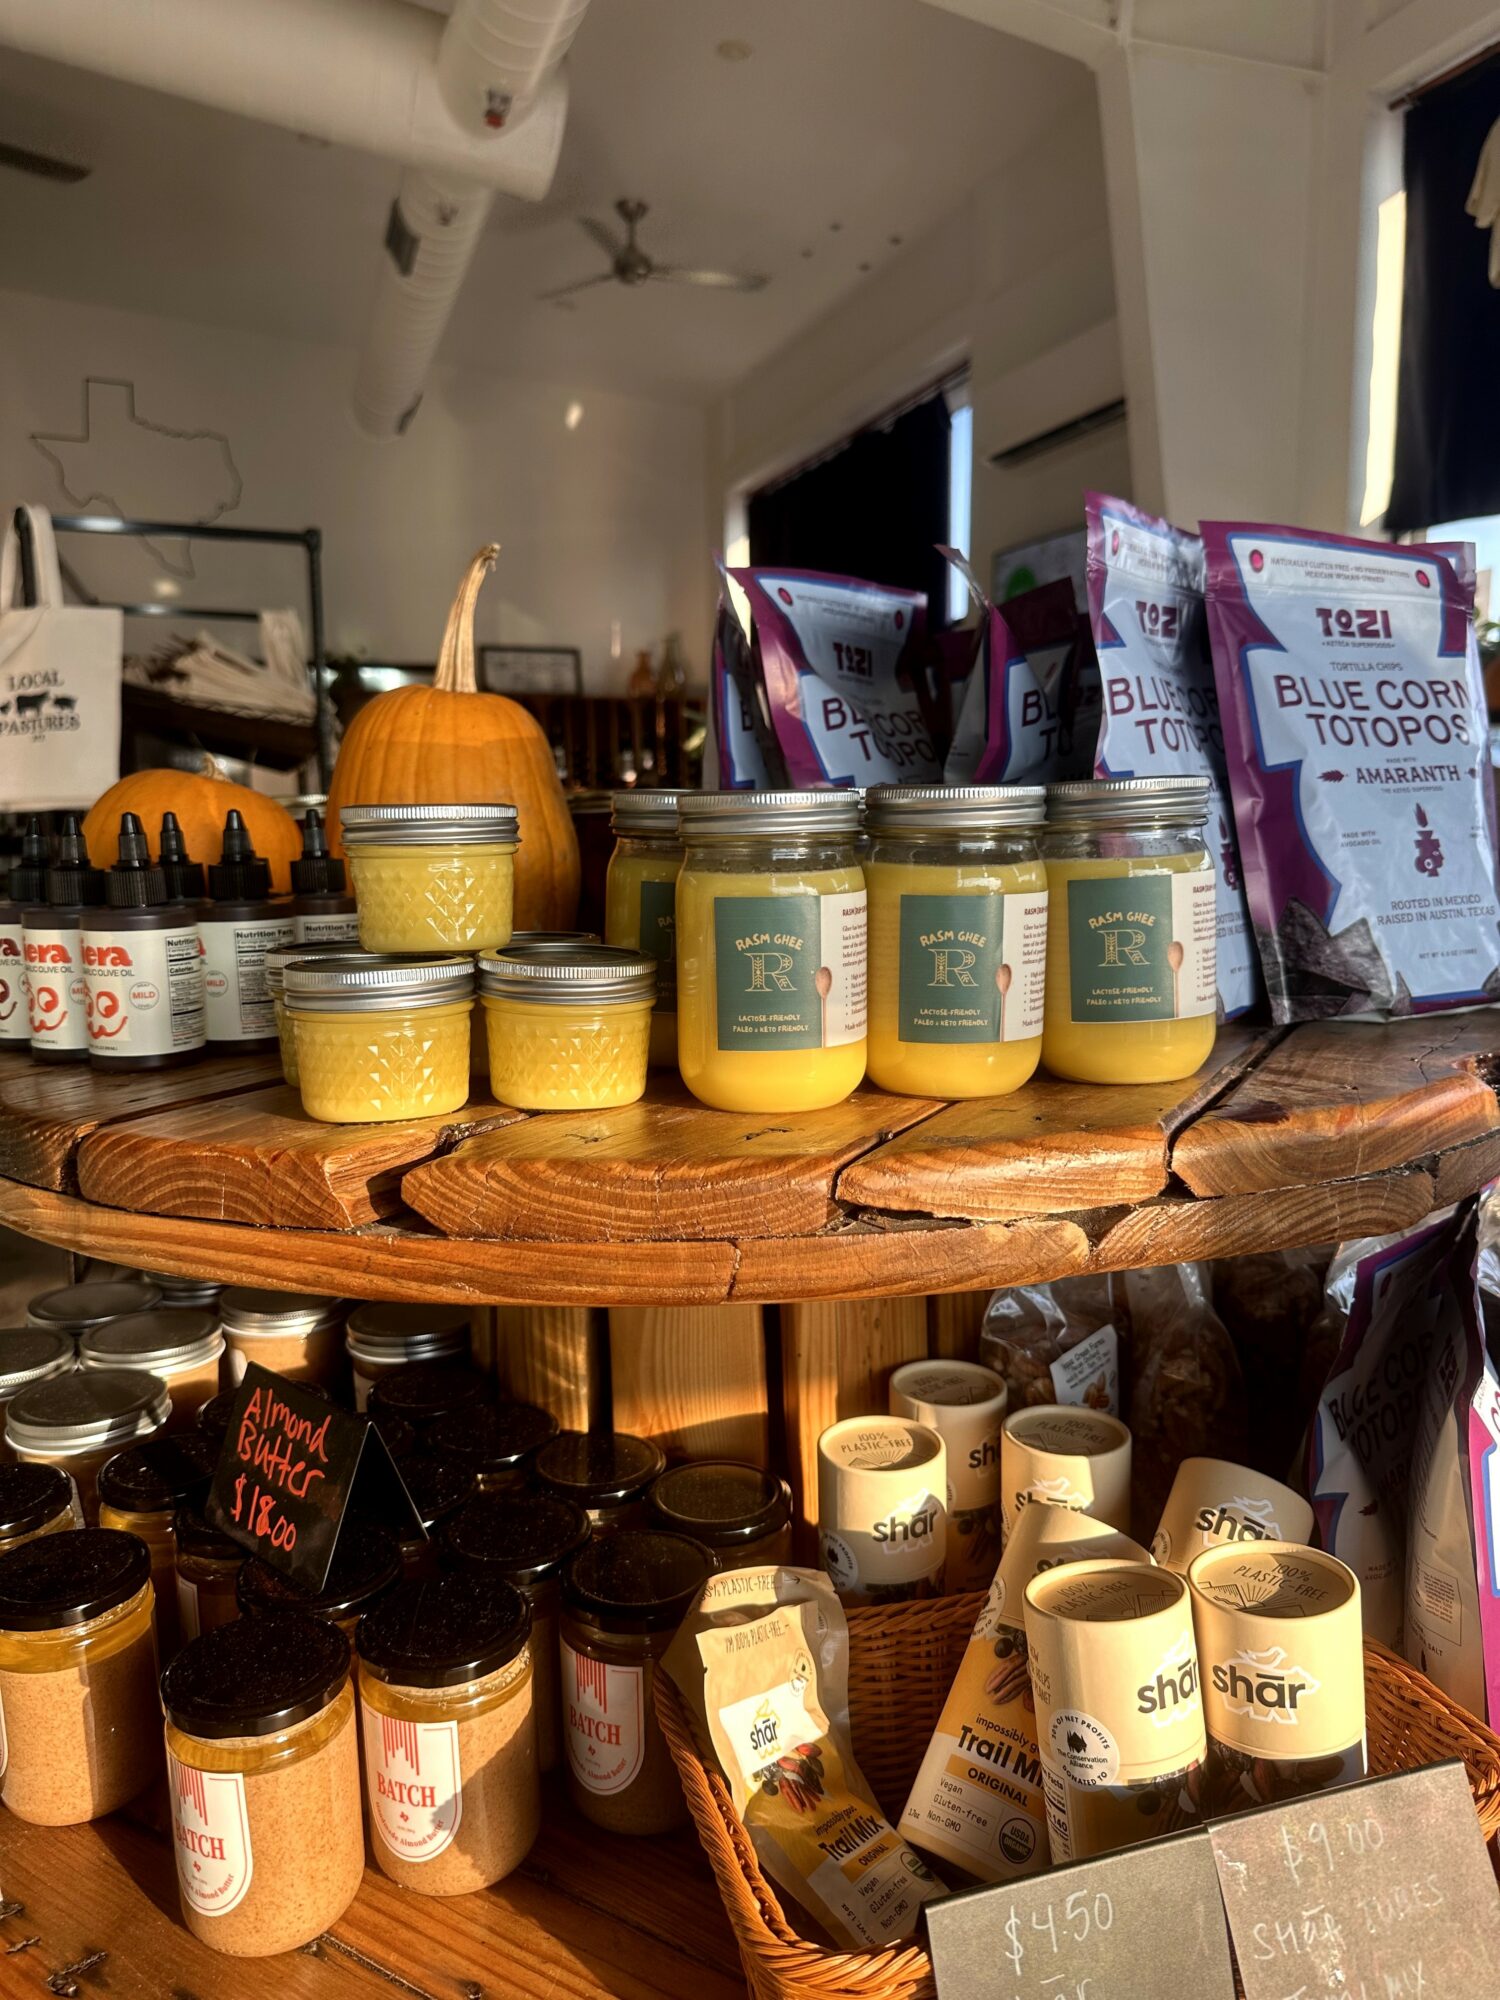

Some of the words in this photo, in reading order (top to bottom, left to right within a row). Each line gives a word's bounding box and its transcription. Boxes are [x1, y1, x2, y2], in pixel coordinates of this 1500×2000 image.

[1134, 600, 1179, 640] TOZ
[1316, 608, 1392, 639] TOZI
[1329, 661, 1374, 672] TORTILLA
[1376, 662, 1403, 671] CHIPS
[8, 668, 65, 692] LOCAL
[1273, 675, 1370, 711] BLUE
[1305, 713, 1471, 748] TOTOPOS
[1357, 765, 1461, 784] AMARANTH
[1391, 899, 1431, 912] ROOTED
[1432, 898, 1443, 908] IN
[1445, 894, 1481, 907] MEXICO
[1089, 912, 1123, 929] RASM
[1126, 911, 1157, 927] GHEE
[1377, 911, 1414, 926] RAISED
[1416, 910, 1427, 921] IN
[1469, 905, 1496, 917] TEXAS
[237, 929, 276, 940] Nutrition
[305, 923, 345, 934] Nutrition
[919, 930, 954, 948] RASM
[957, 929, 986, 948] GHEE
[735, 932, 771, 951] RASM
[774, 933, 805, 950] GHEE
[1097, 929, 1152, 968] R
[60, 965, 76, 974] OIL
[121, 968, 136, 977] OIL
[744, 952, 798, 992] R
[926, 947, 979, 988] R
[207, 978, 227, 988] MILD
[1092, 986, 1153, 997] LACTOSE-FRIENDLY
[131, 990, 156, 1000] MILD
[1086, 997, 1107, 1006] PALEO
[1114, 997, 1130, 1006] KETO
[1130, 995, 1162, 1005] FRIENDLY
[738, 1013, 801, 1025] LACTOSE-FRIENDLY
[913, 1018, 933, 1027] PALEO
[940, 1018, 957, 1027] KETO
[958, 1017, 989, 1027] FRIENDLY
[920, 1007, 982, 1017] LACTOSE-FRIENDLY
[732, 1025, 753, 1035] PALEO
[761, 1025, 778, 1035] KETO
[779, 1024, 810, 1034] FRIENDLY
[244, 1387, 332, 1463] Almond
[858, 1429, 890, 1442] 100%
[840, 1435, 914, 1454] PLASTIC-FREE
[238, 1419, 326, 1499] Butter
[231, 1473, 297, 1552] $18.00
[1270, 1561, 1311, 1583] 100%
[1056, 1580, 1097, 1598] 100%
[1232, 1564, 1329, 1602] PLASTIC-FREE
[1050, 1580, 1134, 1613] PLASTIC-FREE
[1427, 1642, 1443, 1657] SALT
[570, 1703, 622, 1747] BATCH
[975, 1713, 1030, 1750] impossibly
[1065, 1715, 1079, 1724] NET
[1081, 1719, 1111, 1750] PROFITS
[958, 1724, 1014, 1769] Trail
[1012, 1751, 1044, 1789] Mi
[1066, 1750, 1109, 1765] Conservation
[1069, 1759, 1094, 1770] Alliance
[1062, 1764, 1098, 1786] DONATED
[1098, 1771, 1108, 1782] TO
[376, 1770, 438, 1809] BATCH
[939, 1776, 964, 1796] Vegan
[967, 1766, 1029, 1808] ORIGINAL
[926, 1808, 962, 1833] Non-GMO
[932, 1792, 988, 1828] Gluten-free
[1009, 1823, 1030, 1842] USDA
[1053, 1815, 1067, 1831] 140
[818, 1827, 858, 1860] Trail
[851, 1813, 885, 1842] Mix
[857, 1875, 881, 1899] Vegan
[866, 1873, 911, 1914] Gluten-free
[1005, 1889, 1113, 1976] $4.50
